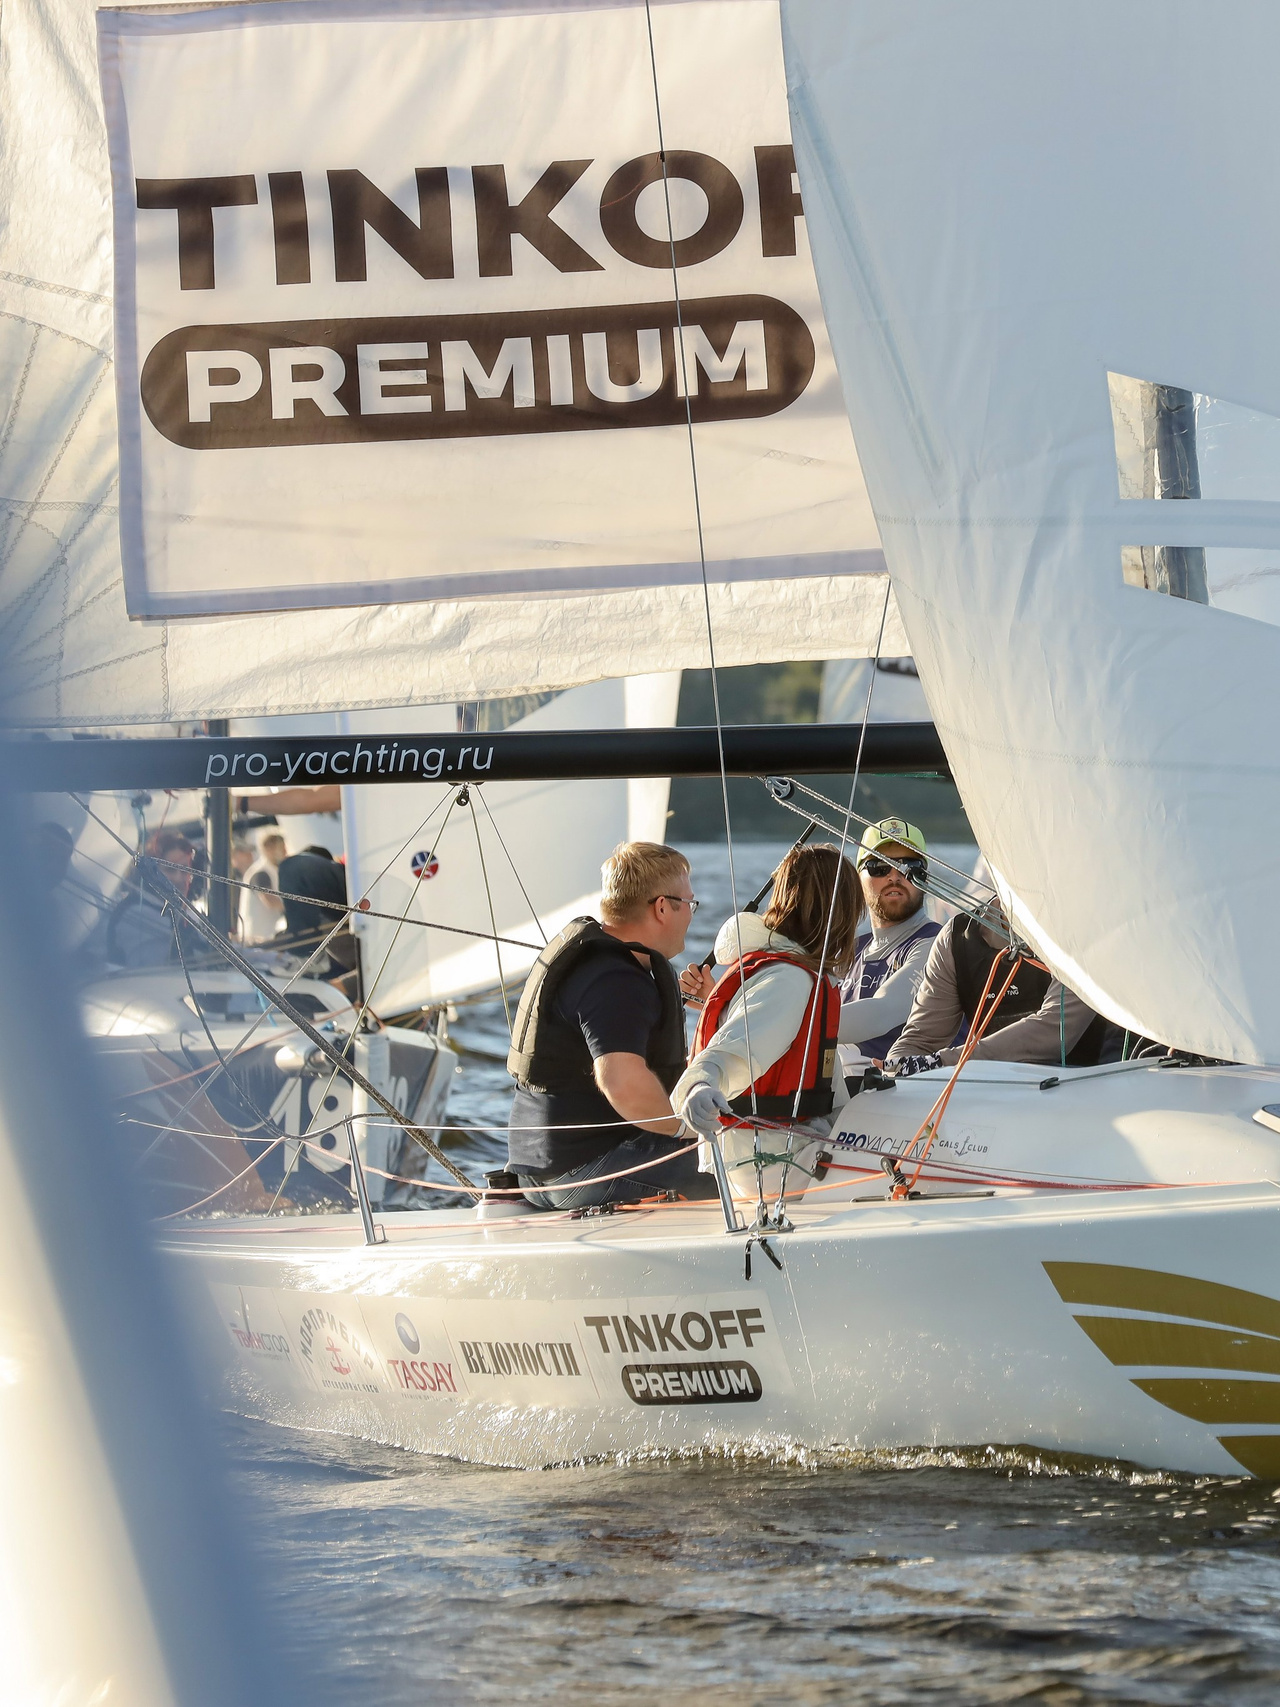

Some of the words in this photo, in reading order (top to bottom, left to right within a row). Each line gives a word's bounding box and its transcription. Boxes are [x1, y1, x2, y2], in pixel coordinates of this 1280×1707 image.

[185, 320, 771, 424] PREMIUM
[205, 742, 494, 783] pro-yachting.ru
[269, 1075, 354, 1173] 18
[832, 1131, 935, 1162] PROYACHTNG
[967, 1143, 989, 1153] CLUB
[583, 1308, 766, 1353] TINKOFF
[387, 1360, 458, 1392] TASSAY
[459, 1341, 582, 1379] ВЕДОМОСТИ
[628, 1368, 755, 1398] PREMIUM
